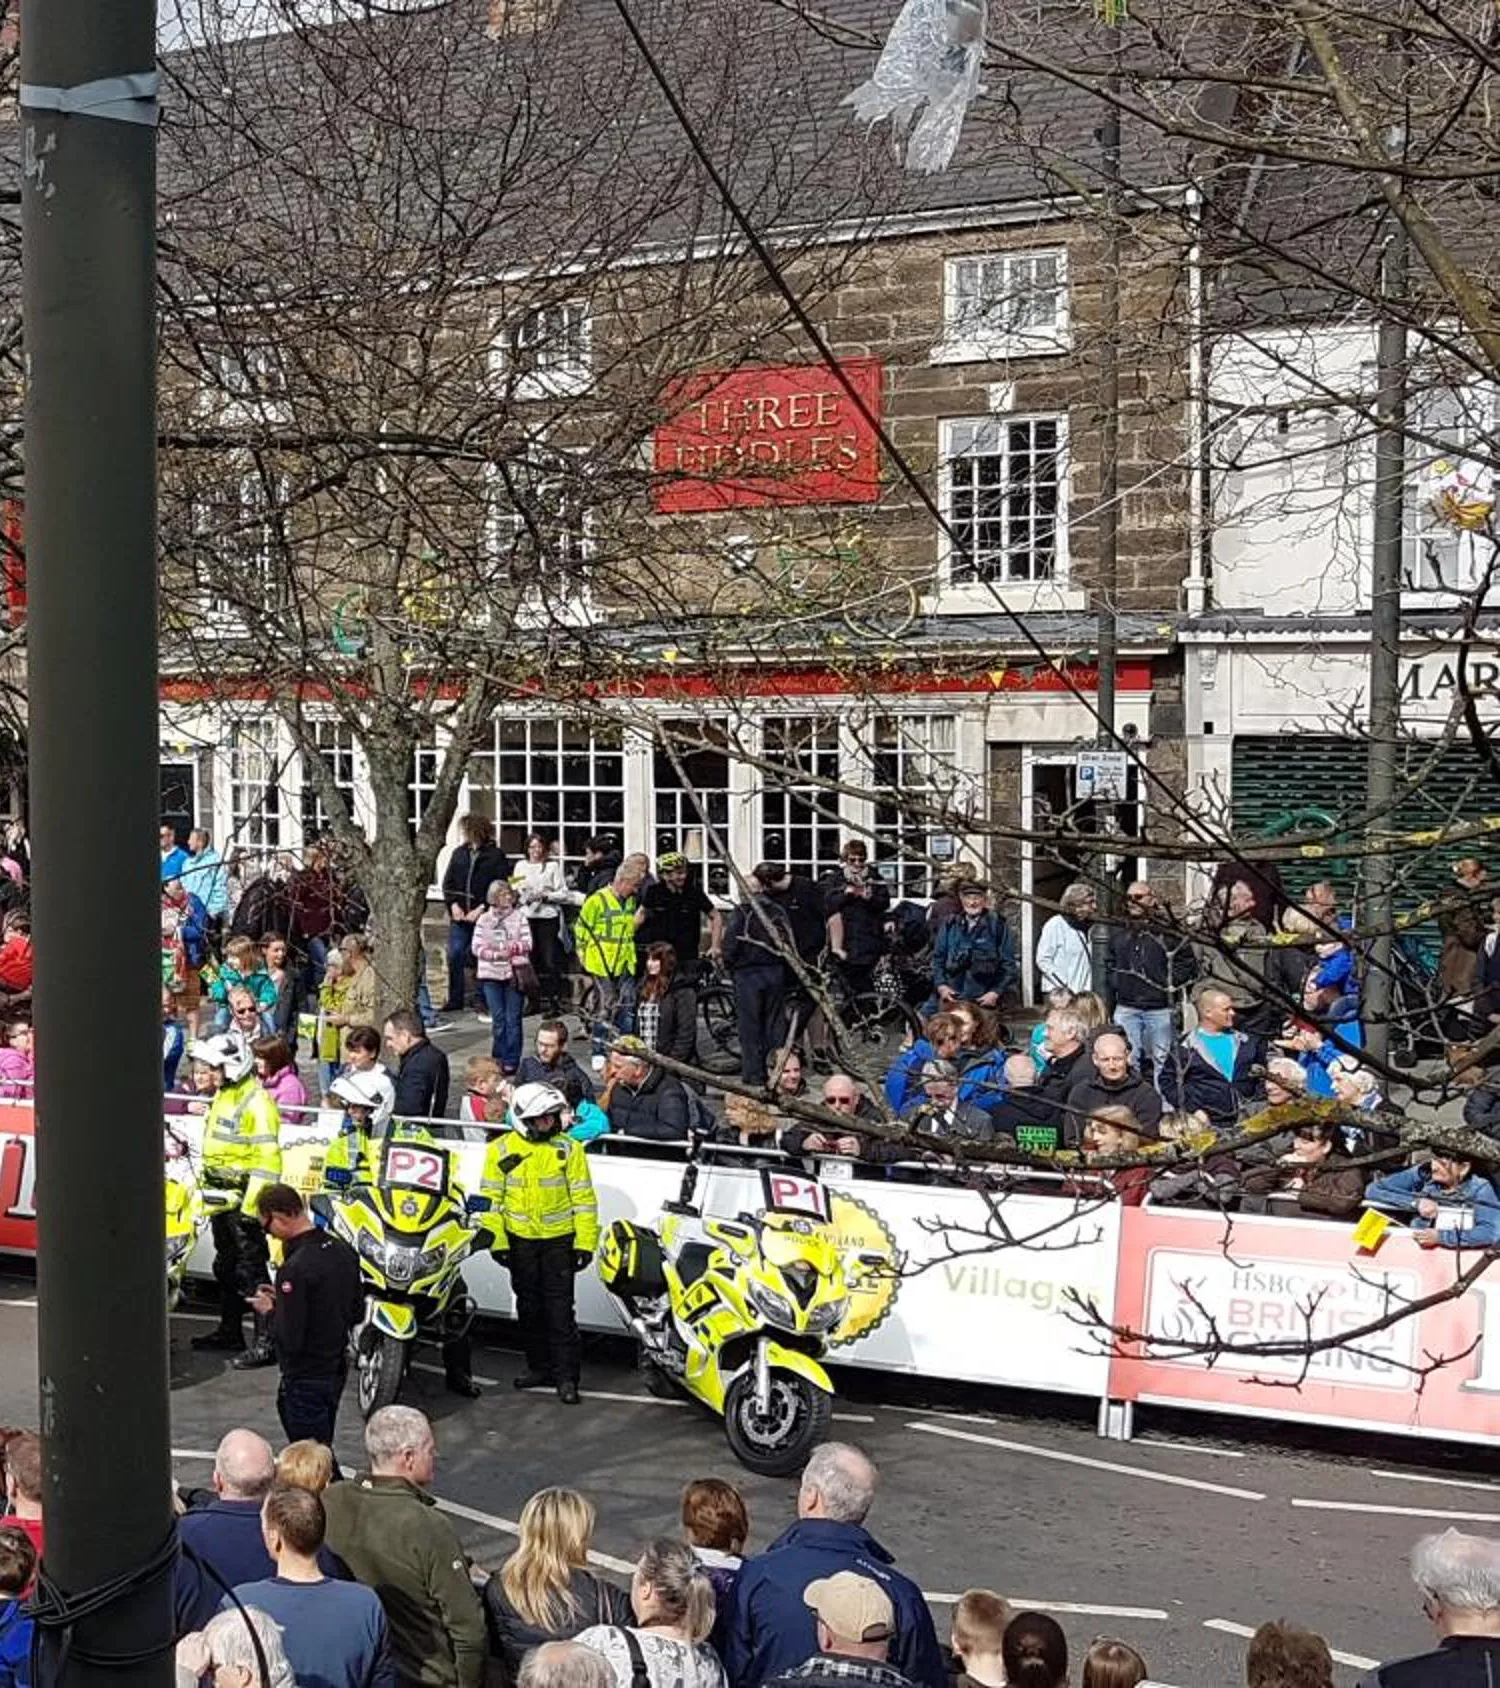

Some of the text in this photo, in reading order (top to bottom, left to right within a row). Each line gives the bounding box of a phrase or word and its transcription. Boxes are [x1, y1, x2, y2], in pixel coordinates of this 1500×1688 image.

[691, 391, 843, 435] THREE
[388, 1151, 441, 1186] P2
[772, 1178, 821, 1213] P1
[943, 1263, 1100, 1310] Villag
[1232, 1270, 1304, 1298] HSBC
[1227, 1298, 1396, 1342] BRIIS
